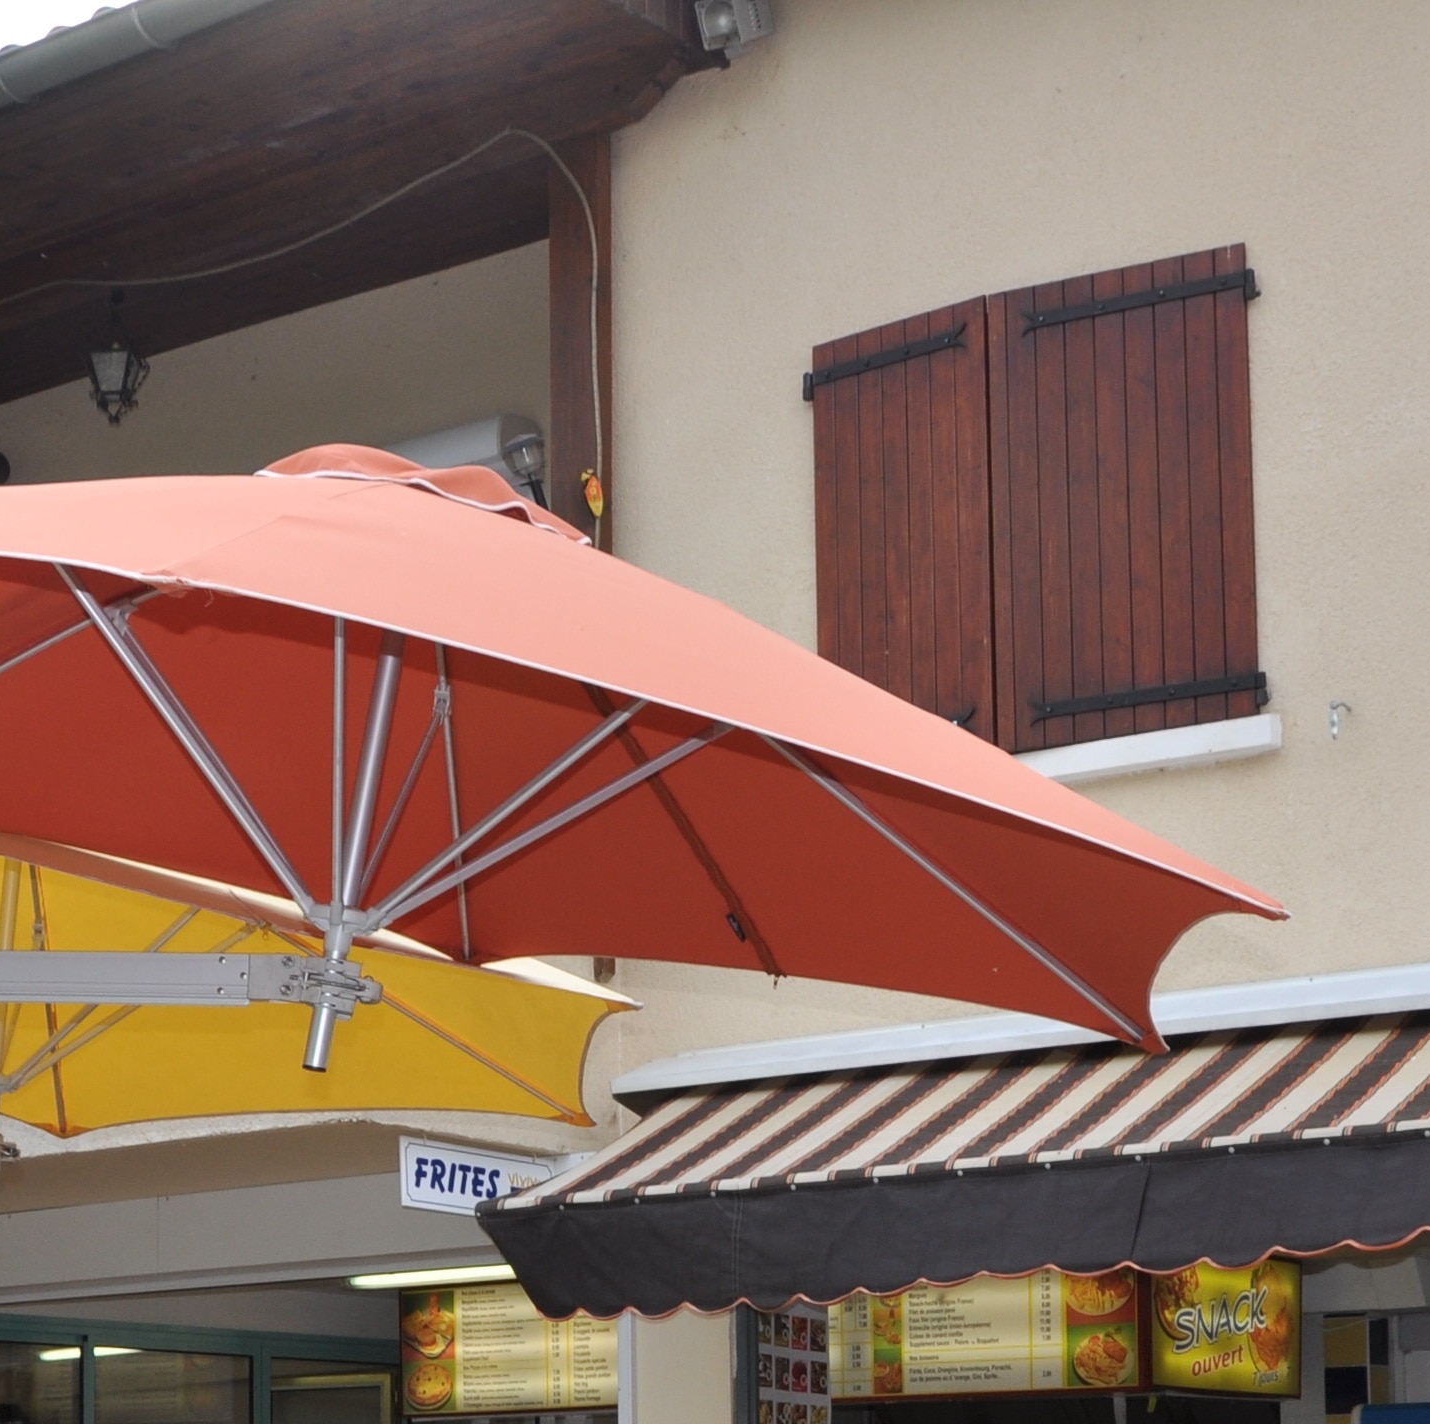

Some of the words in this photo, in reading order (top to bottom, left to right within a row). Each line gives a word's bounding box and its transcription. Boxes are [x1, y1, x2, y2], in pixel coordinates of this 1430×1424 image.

[414, 1156, 501, 1199] FRITES
[1172, 1285, 1269, 1355] SNACK
[1191, 1344, 1245, 1377] ouvert
